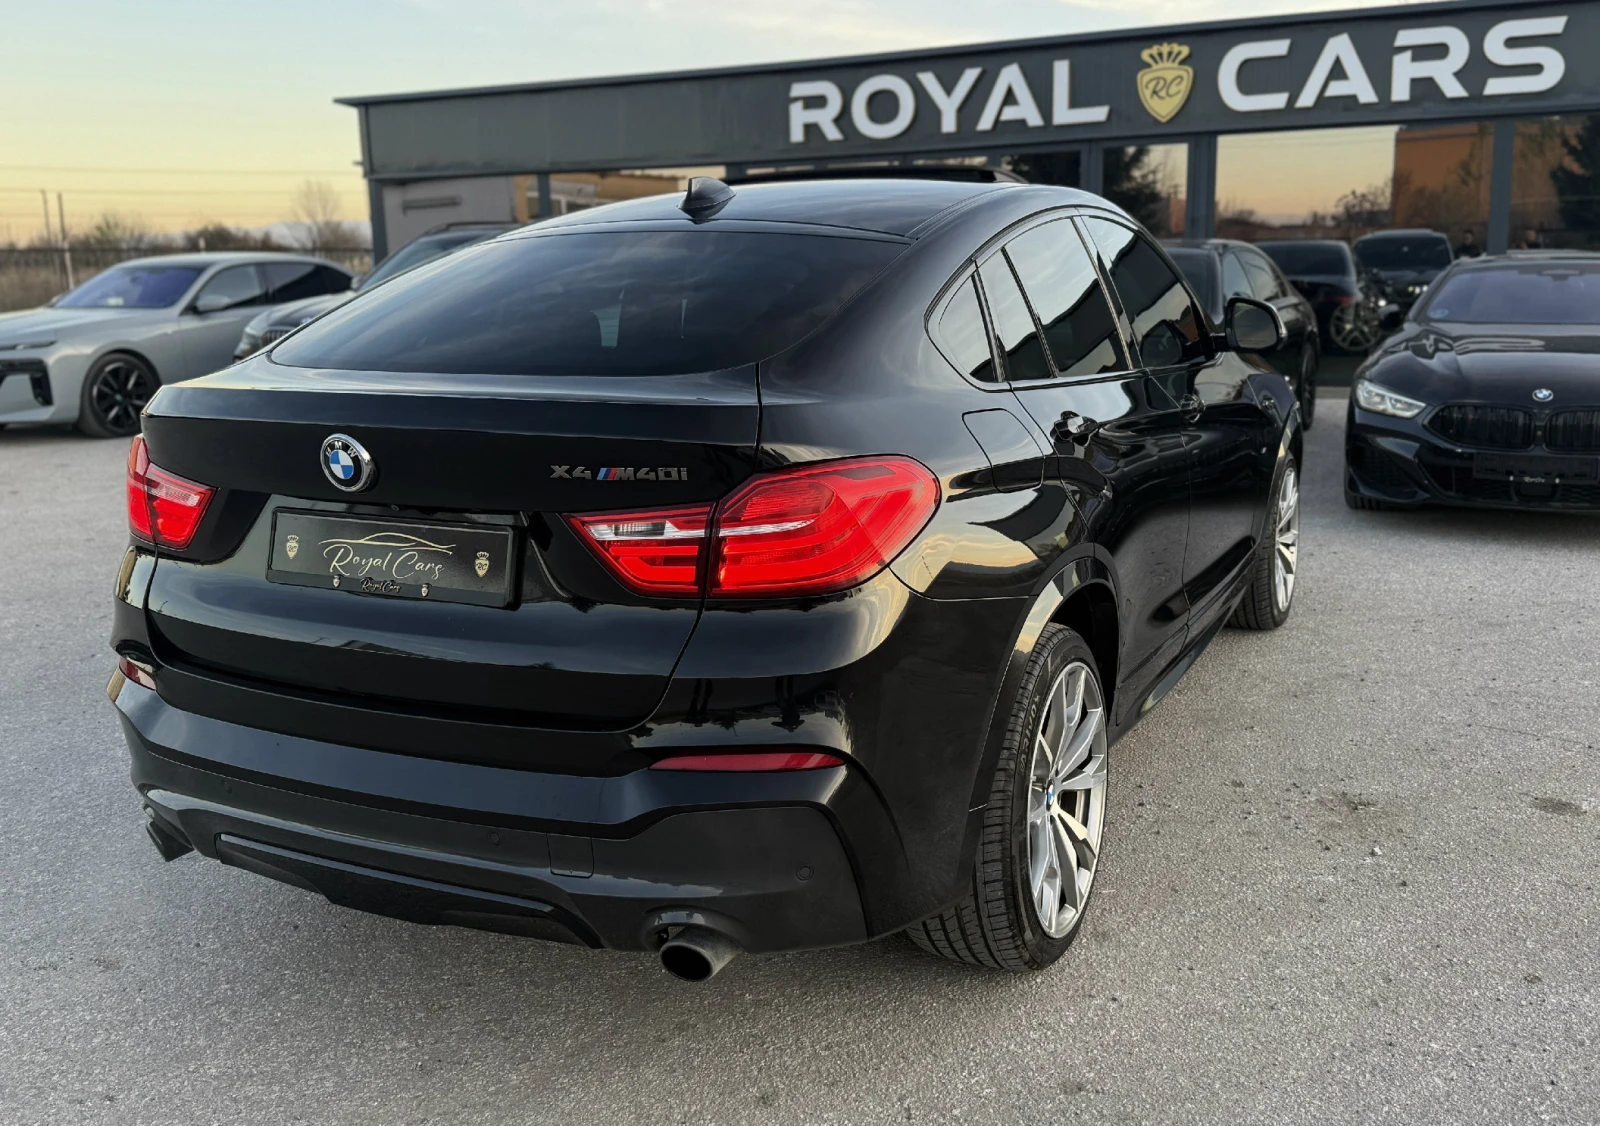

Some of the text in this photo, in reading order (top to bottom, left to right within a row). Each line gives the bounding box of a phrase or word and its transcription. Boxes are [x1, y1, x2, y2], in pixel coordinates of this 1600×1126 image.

[788, 15, 1569, 143] ROYAL CARS
[1145, 75, 1185, 101] RC
[325, 440, 357, 458] BMW
[550, 465, 593, 480] X4
[323, 544, 446, 580] Royal Cars
